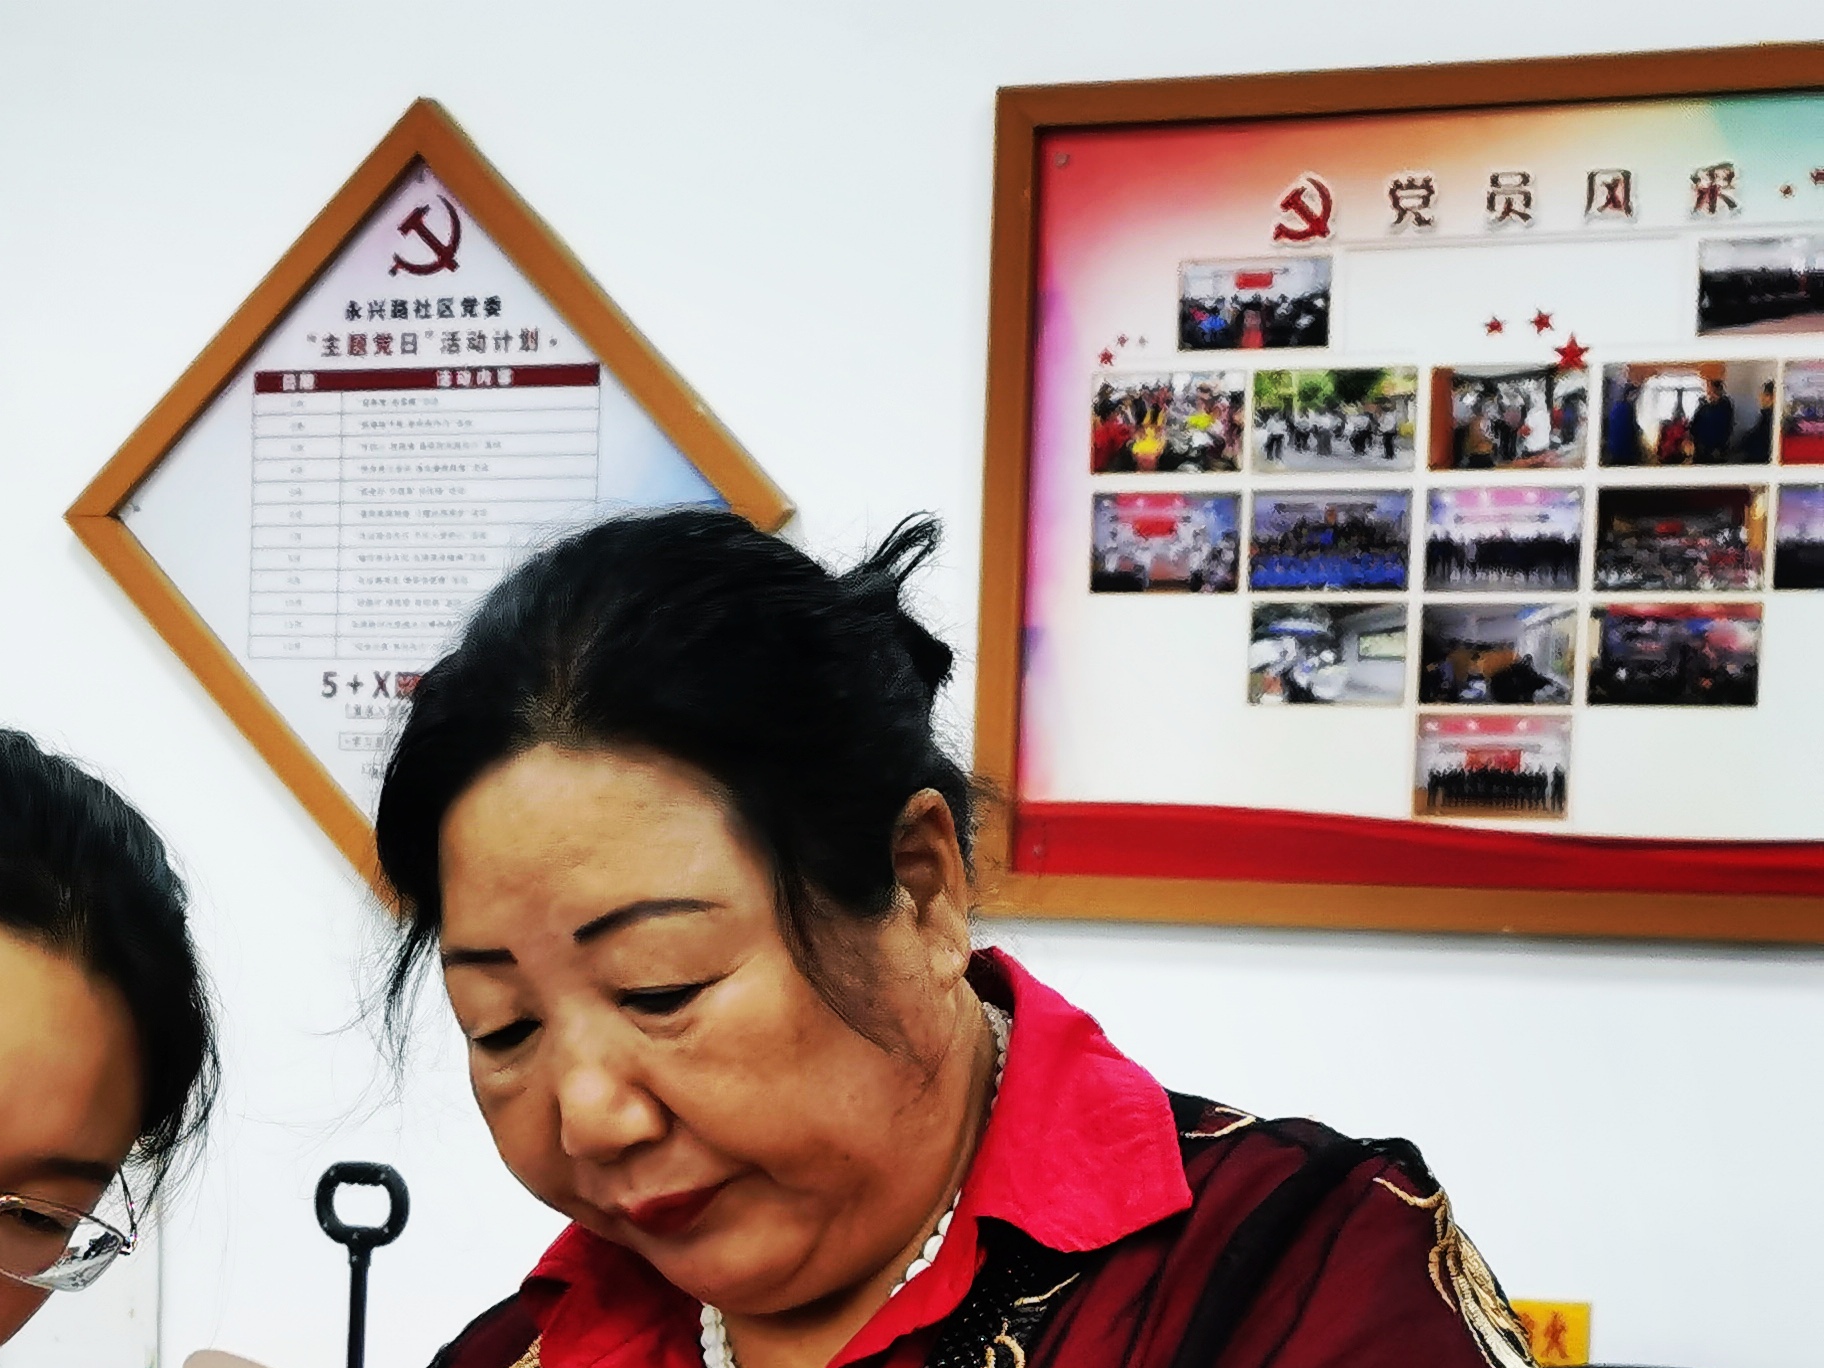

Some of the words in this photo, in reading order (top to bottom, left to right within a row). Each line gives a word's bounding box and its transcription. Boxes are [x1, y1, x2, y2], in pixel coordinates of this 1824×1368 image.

[1388, 160, 1738, 228] 党员风采
[344, 295, 502, 321] 永兴路社区党委
